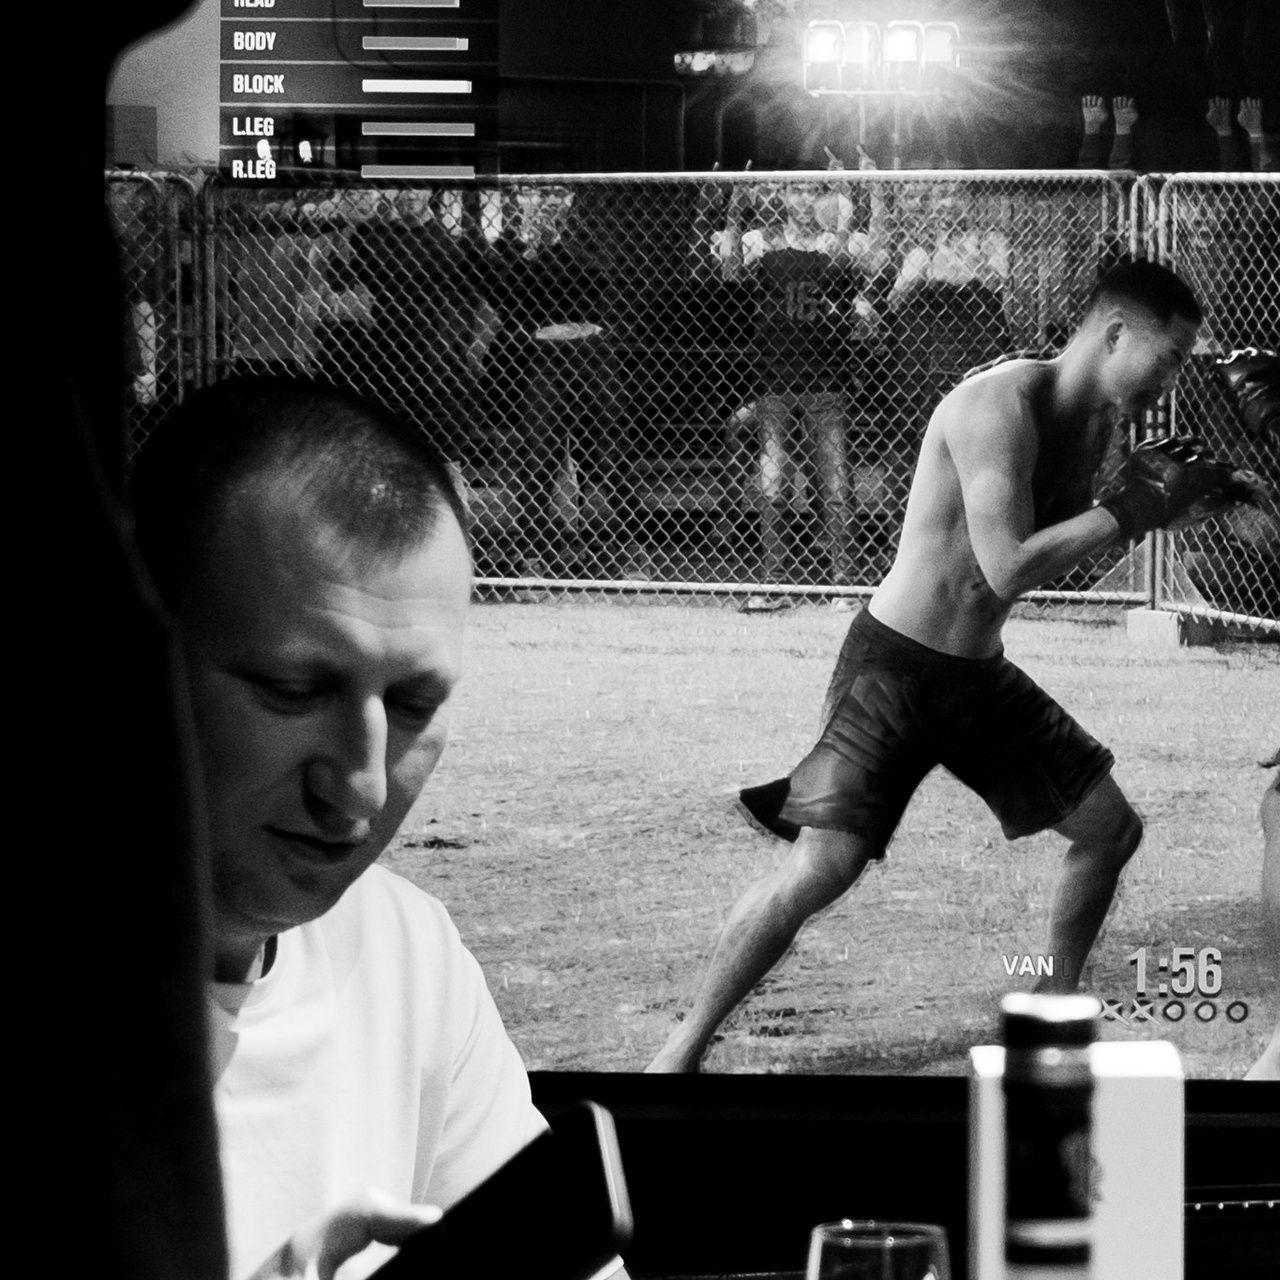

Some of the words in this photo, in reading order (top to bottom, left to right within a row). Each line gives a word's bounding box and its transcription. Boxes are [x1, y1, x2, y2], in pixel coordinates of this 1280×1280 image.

[233, 31, 277, 52] BODY
[233, 74, 285, 94] BLOCK
[232, 117, 274, 137] L.LEG
[232, 160, 277, 180] R.LEG
[1001, 955, 1054, 977] VAN
[1128, 945, 1223, 996] 1:56
